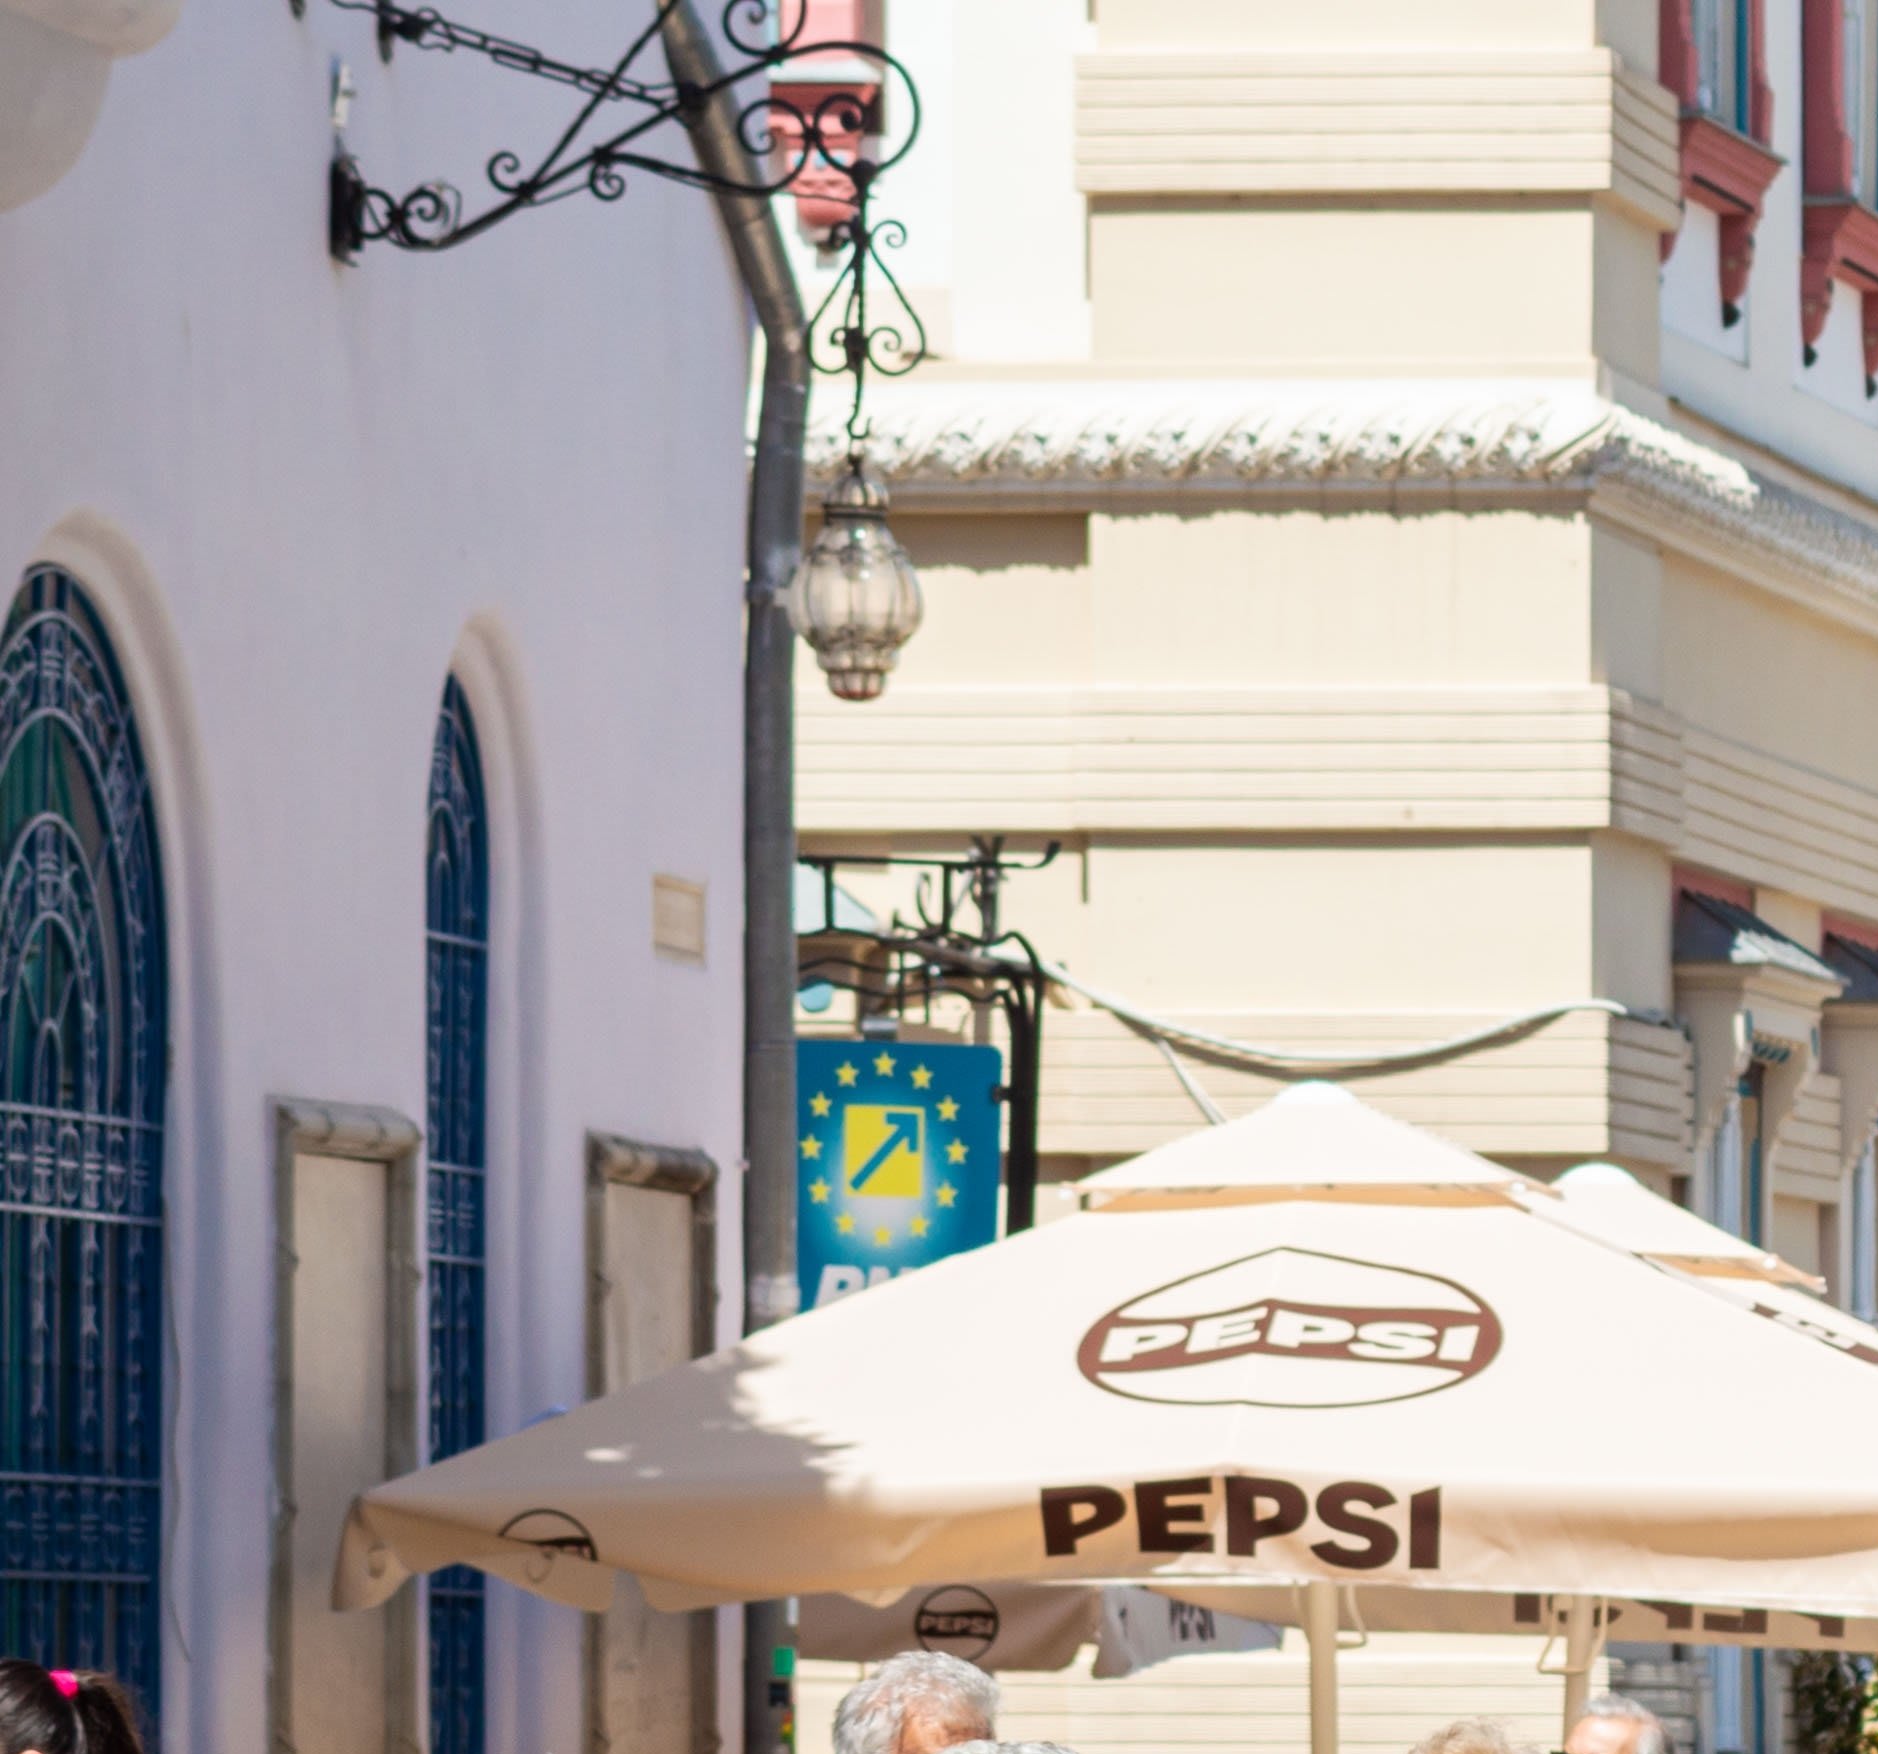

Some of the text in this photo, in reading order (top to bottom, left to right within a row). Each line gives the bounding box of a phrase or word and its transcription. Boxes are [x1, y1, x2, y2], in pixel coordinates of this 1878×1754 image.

[1100, 1305, 1481, 1363] PEPSI
[1040, 1474, 1442, 1571] PEPSI
[920, 1614, 993, 1635] PEPSI
